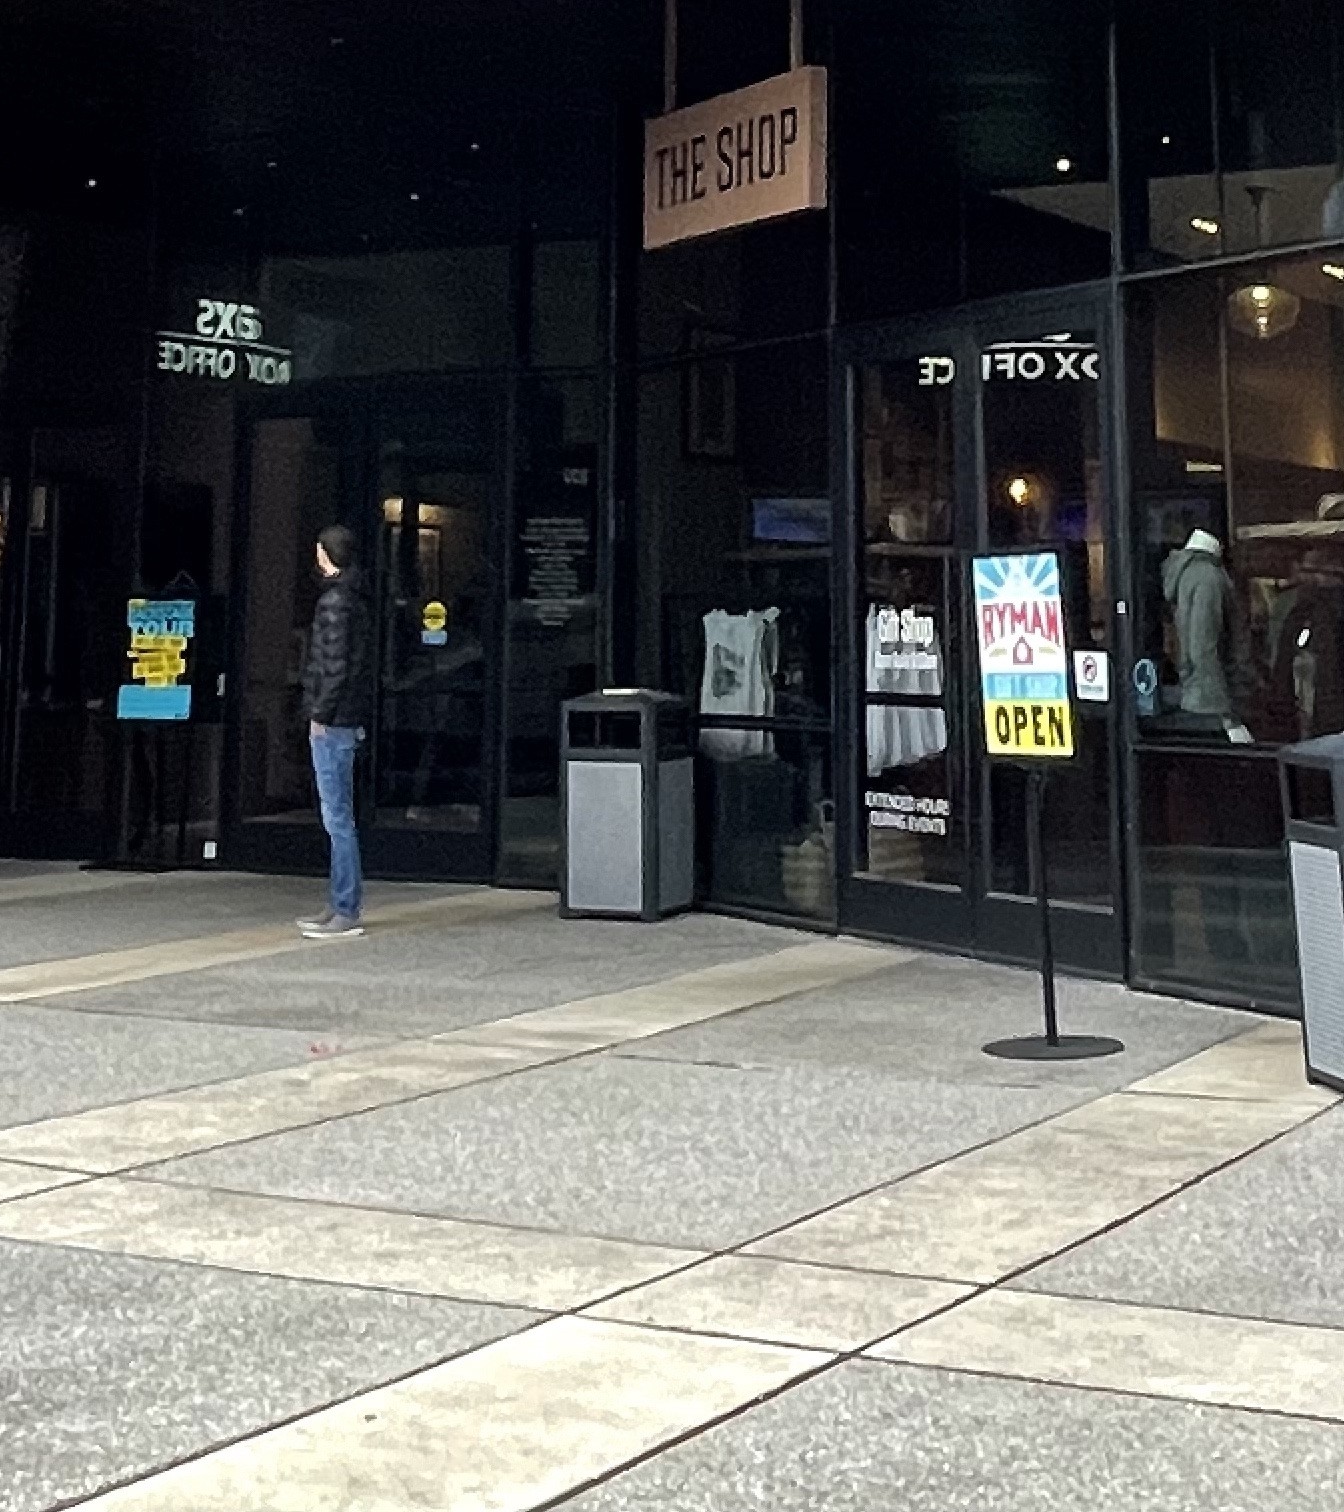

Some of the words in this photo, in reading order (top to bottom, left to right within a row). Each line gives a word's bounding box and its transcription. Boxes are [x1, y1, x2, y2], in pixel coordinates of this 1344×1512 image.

[656, 134, 706, 209] THE
[716, 106, 798, 193] SHOP
[982, 601, 1061, 649] RYMAN
[995, 704, 1066, 748] OPEN
